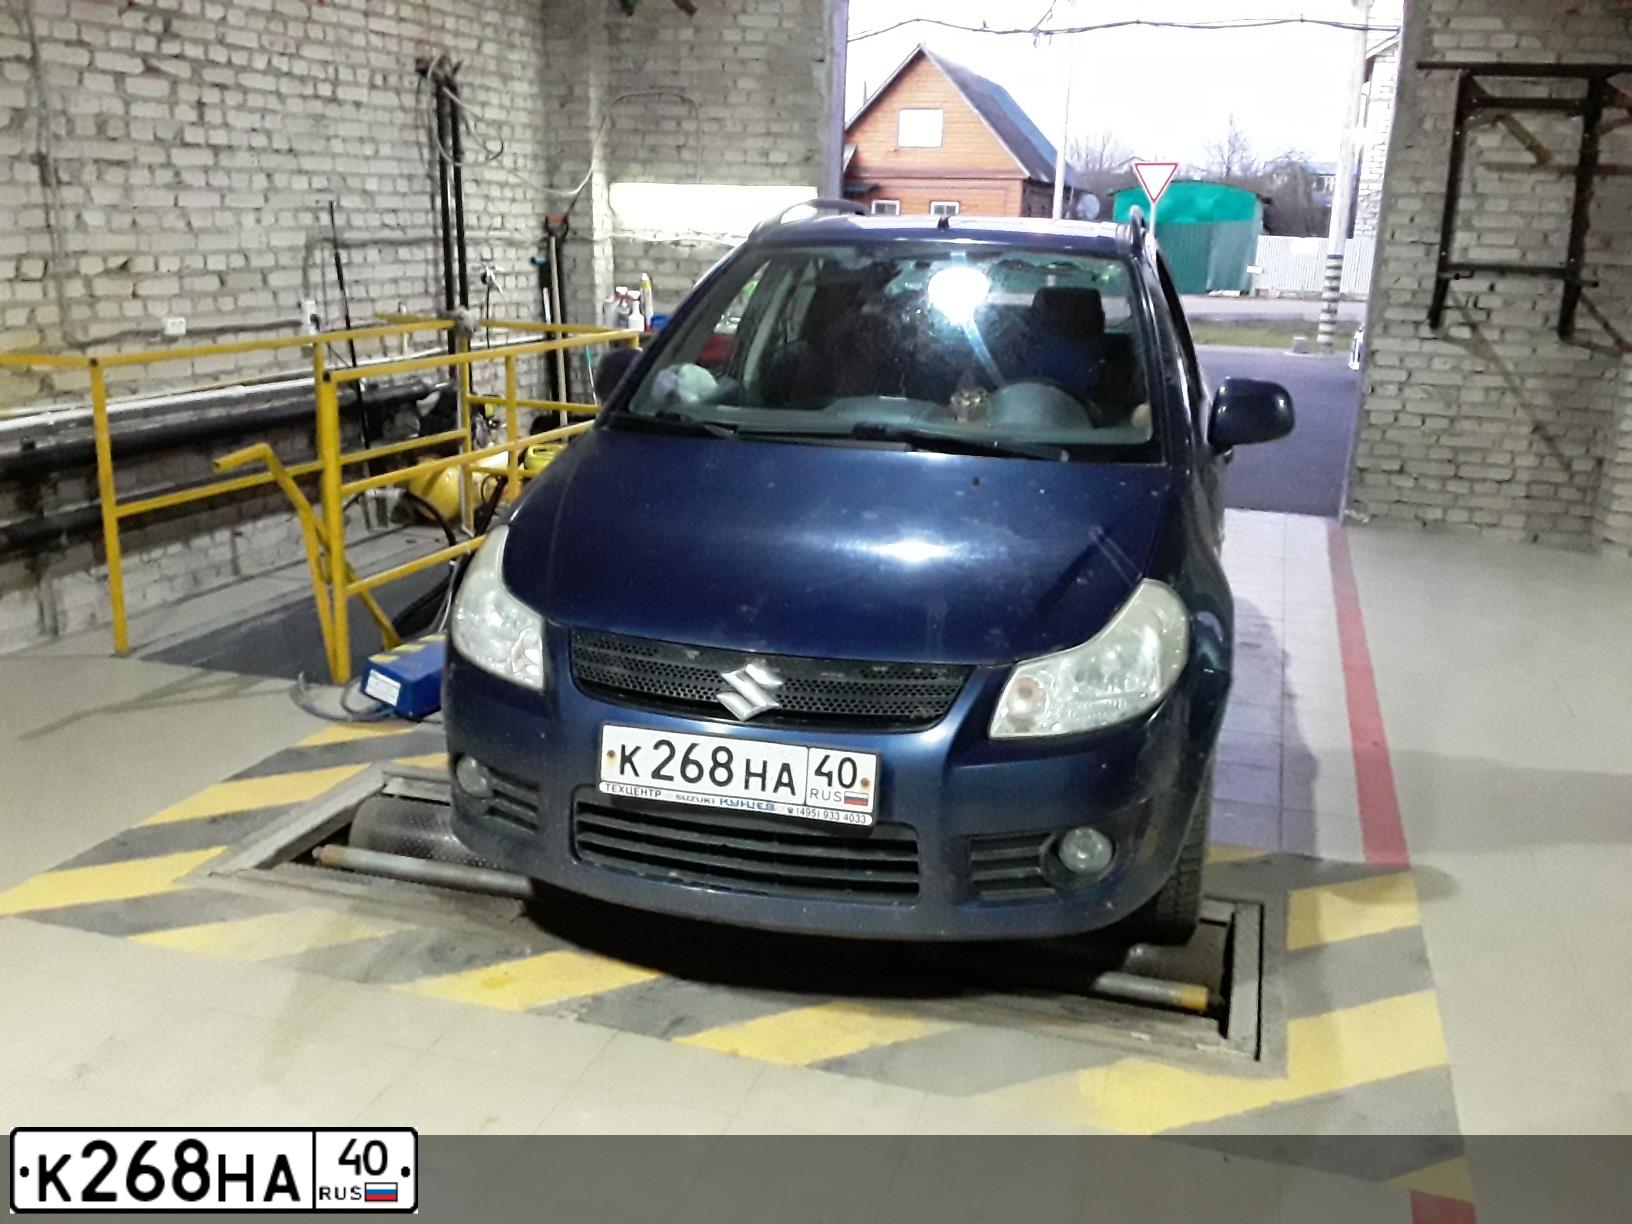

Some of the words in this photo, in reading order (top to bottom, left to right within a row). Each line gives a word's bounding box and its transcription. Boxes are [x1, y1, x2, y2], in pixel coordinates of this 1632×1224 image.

[814, 754, 858, 789] 40
[605, 783, 662, 798] ТЕХЦЕНТР
[796, 806, 820, 818] (495)
[823, 809, 840, 821] 933
[843, 812, 867, 825] 4033
[810, 788, 843, 803] RUS
